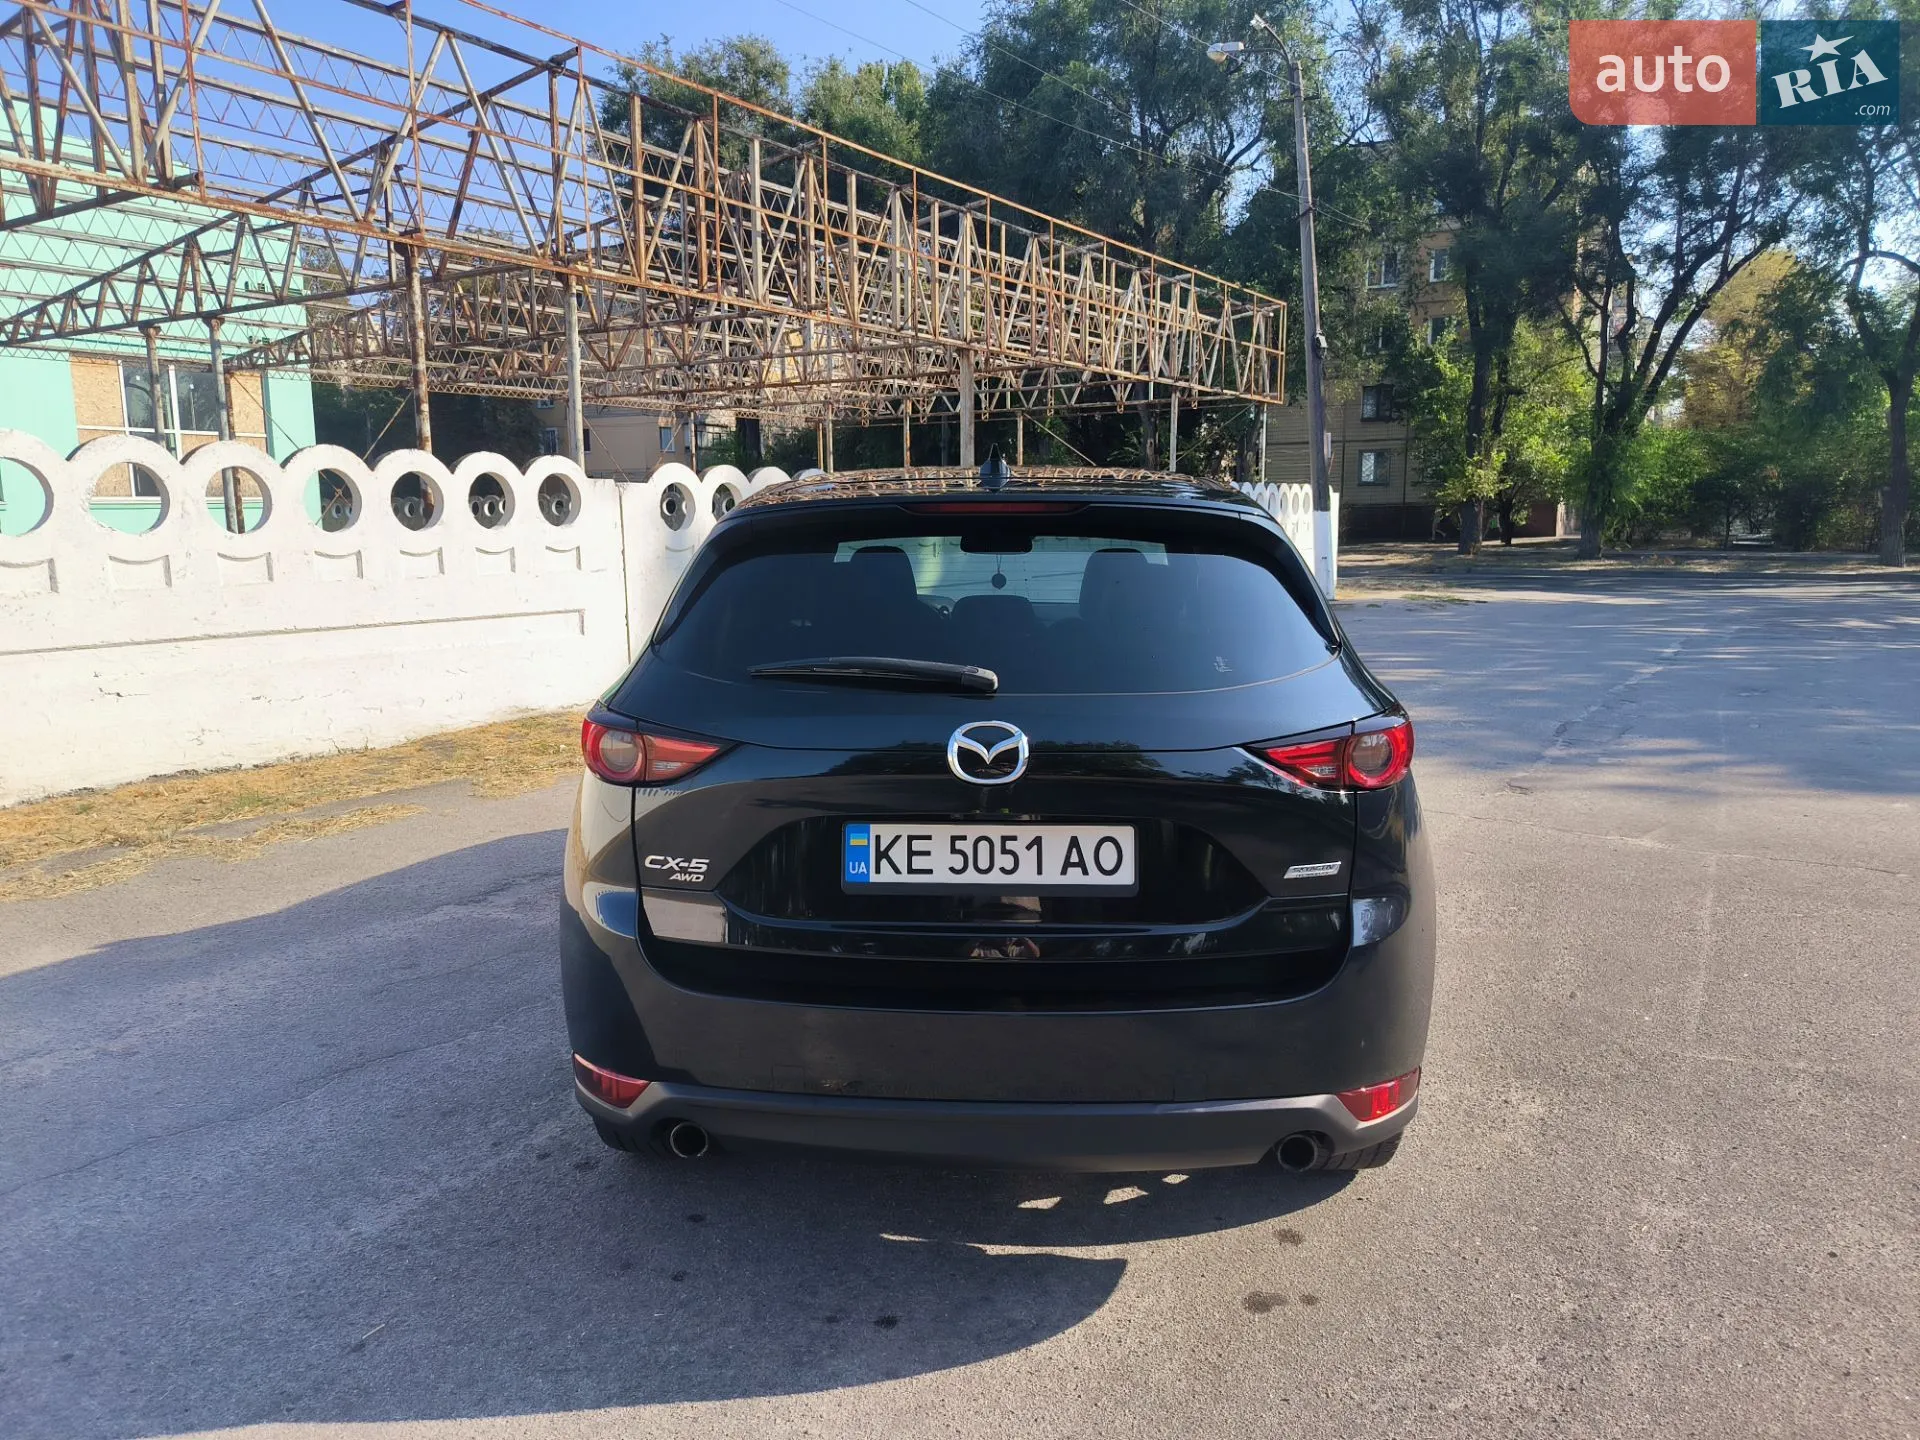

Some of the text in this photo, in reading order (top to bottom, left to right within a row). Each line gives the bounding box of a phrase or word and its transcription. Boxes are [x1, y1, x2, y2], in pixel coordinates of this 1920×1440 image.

[644, 854, 710, 873] CX-5
[874, 834, 1123, 877] KE 5051 AO
[849, 861, 868, 875] UA
[669, 872, 705, 882] AWD
